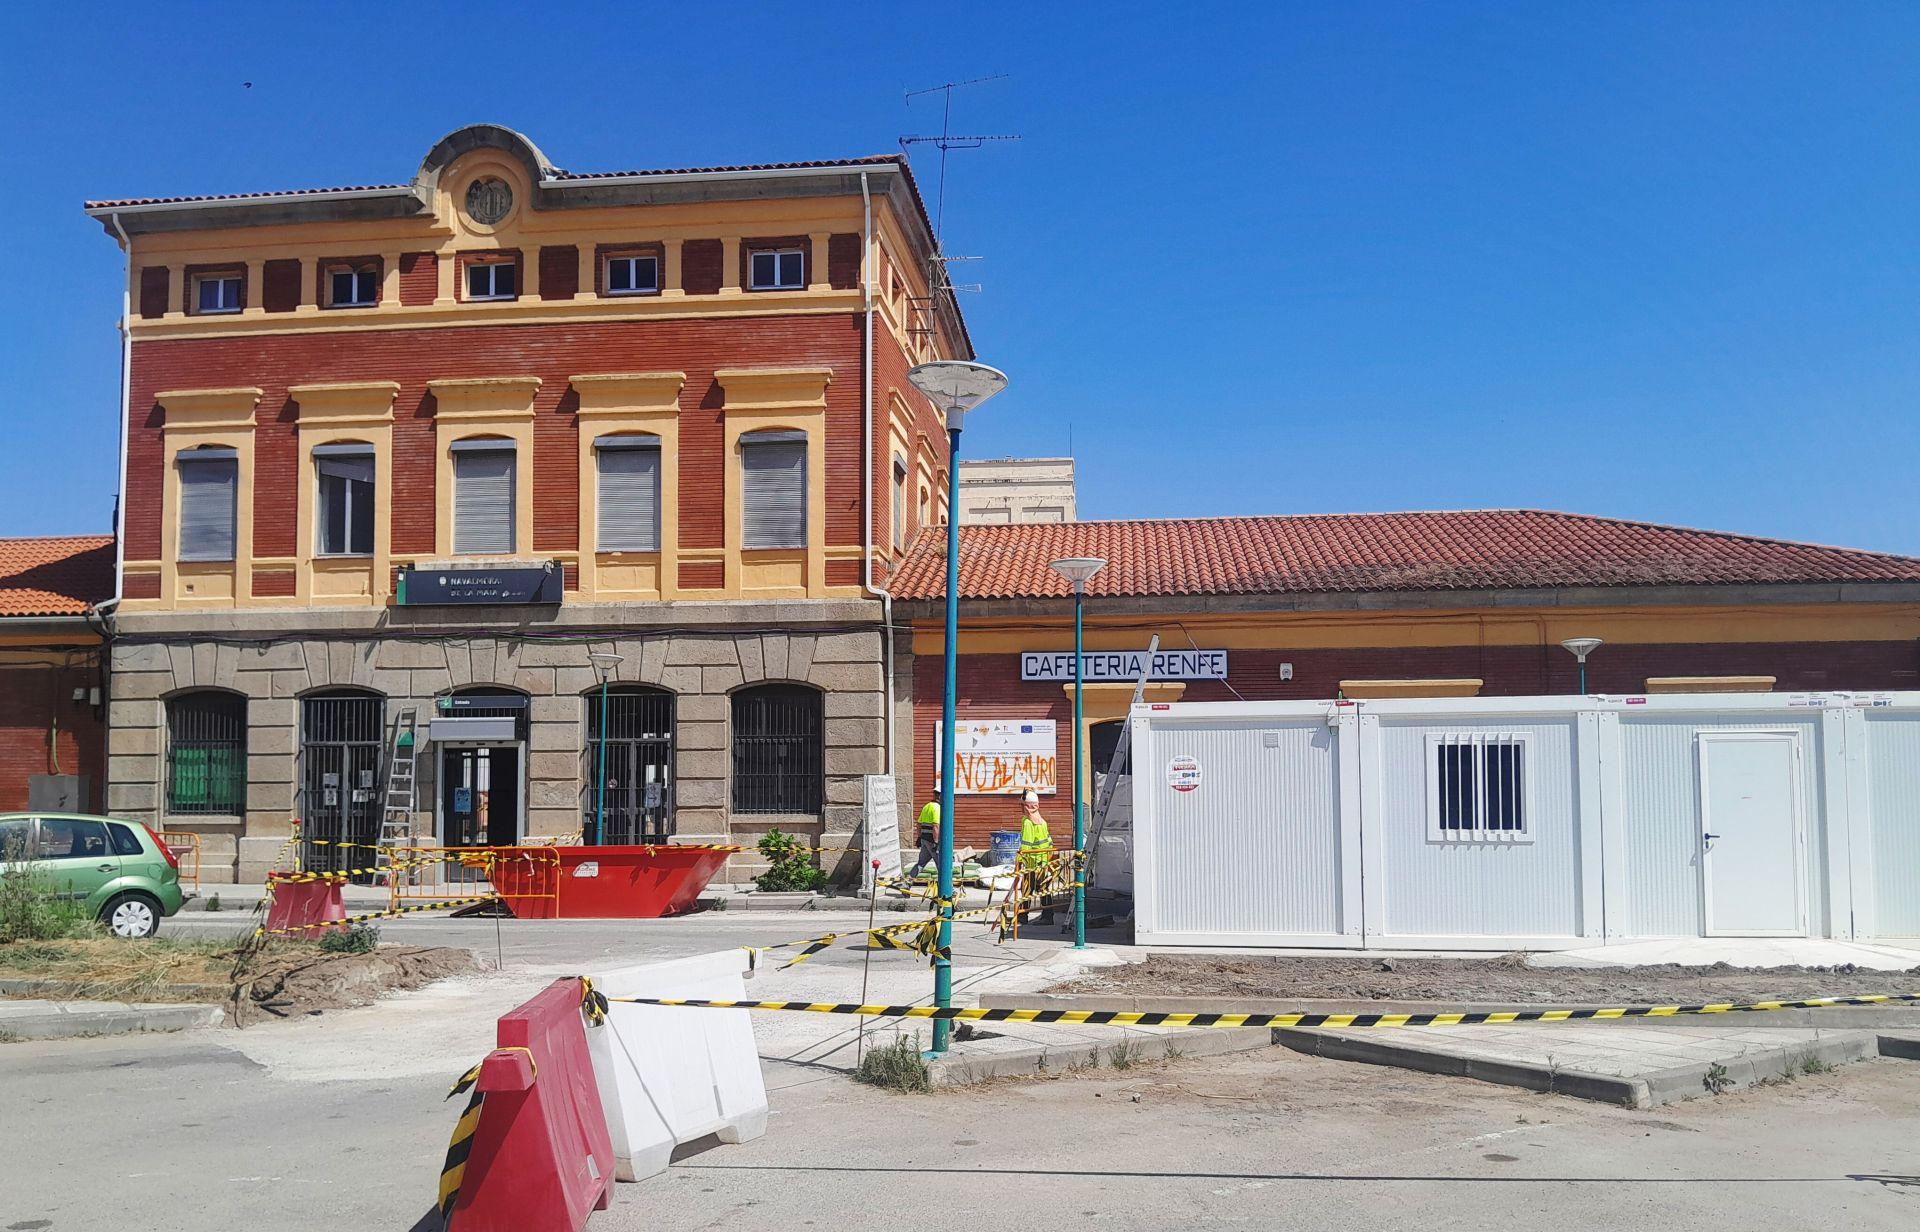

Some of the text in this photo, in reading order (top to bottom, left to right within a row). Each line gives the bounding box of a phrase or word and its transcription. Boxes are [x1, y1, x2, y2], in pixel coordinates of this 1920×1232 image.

[1025, 654, 1224, 677] CAFETERIA RENFE
[955, 752, 987, 790] NO
[1013, 755, 1056, 787] MURO
